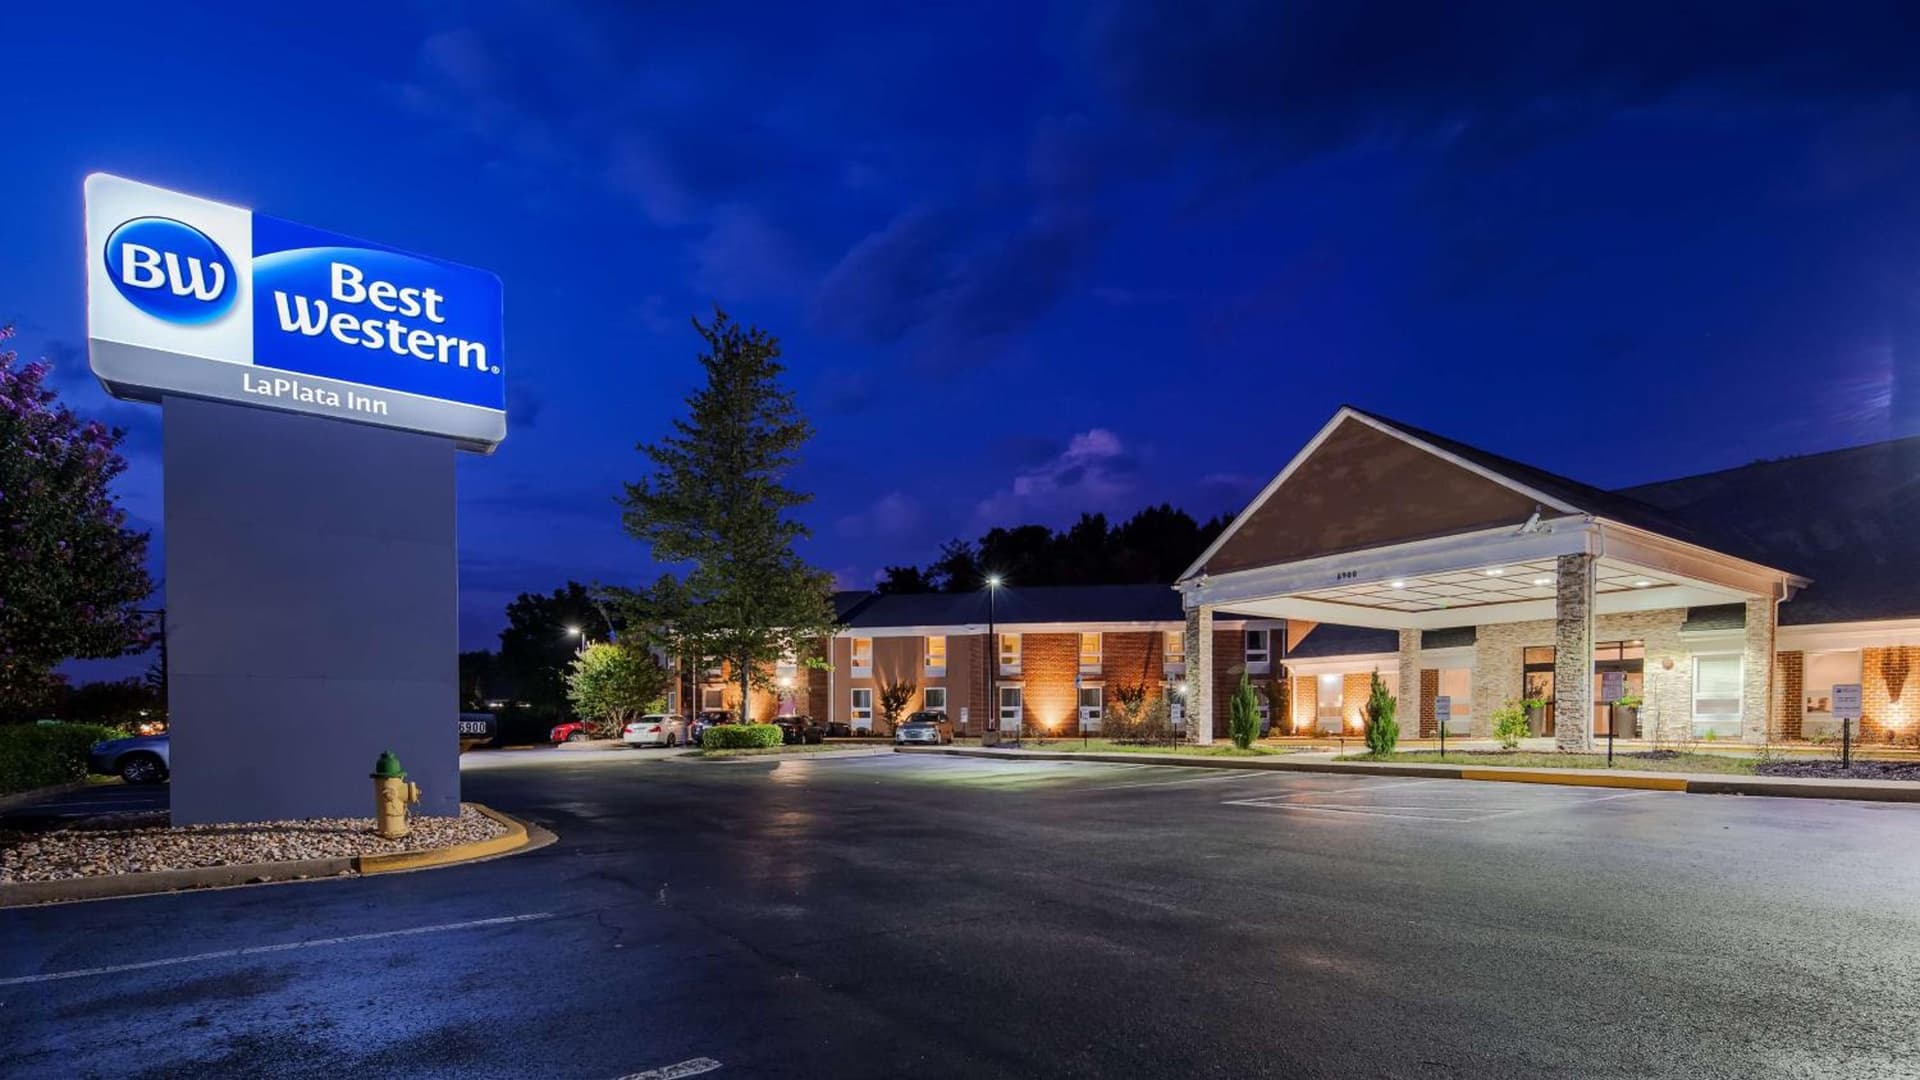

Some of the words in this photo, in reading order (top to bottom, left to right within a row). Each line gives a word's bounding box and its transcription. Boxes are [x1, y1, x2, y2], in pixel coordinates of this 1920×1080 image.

[121, 241, 226, 302] BW
[331, 261, 446, 324] Best
[243, 372, 341, 408] LaPlata
[347, 391, 389, 416] Inn
[459, 721, 486, 734] 6900
